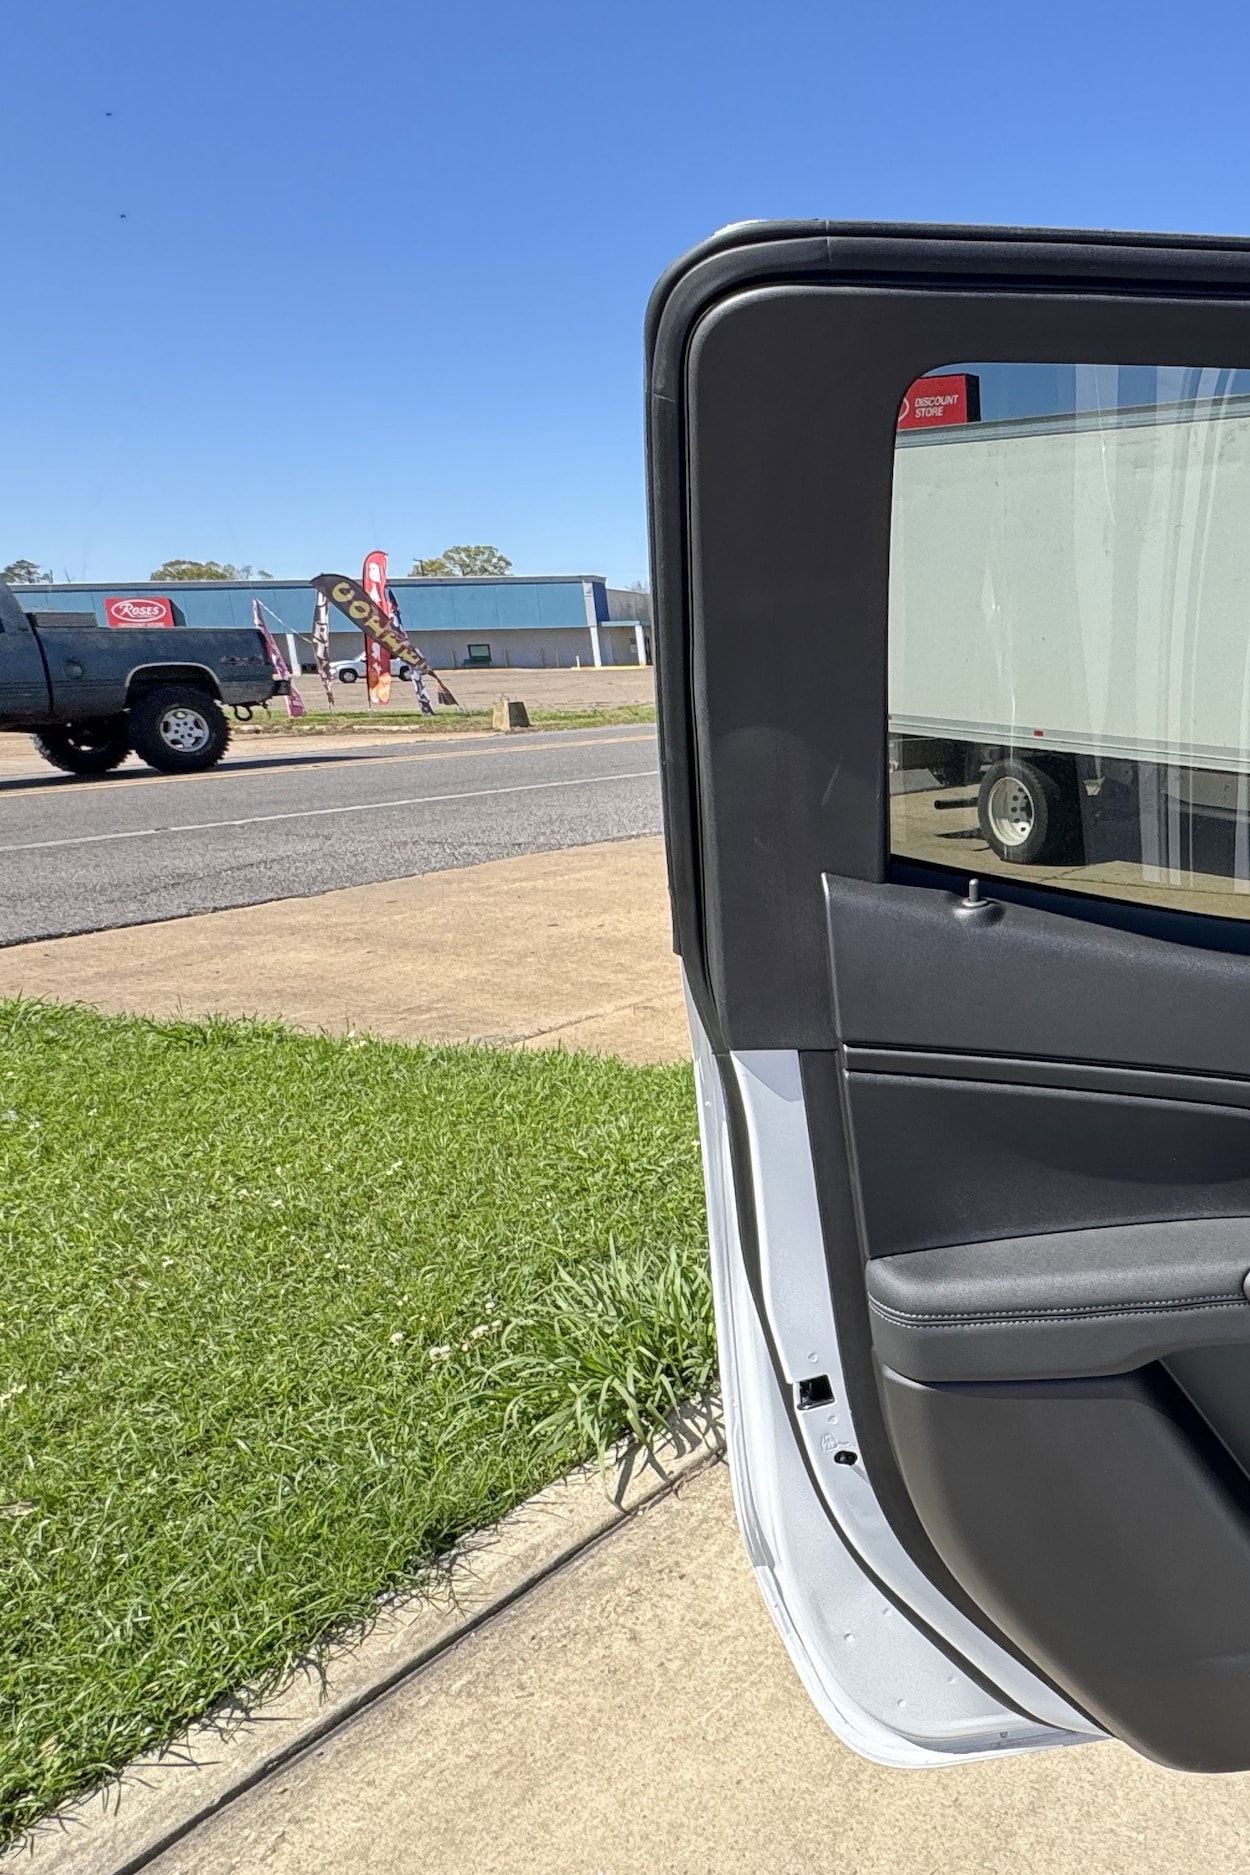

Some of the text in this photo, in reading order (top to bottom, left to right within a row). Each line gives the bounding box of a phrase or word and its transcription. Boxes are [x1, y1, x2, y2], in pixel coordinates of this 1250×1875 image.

[914, 394, 960, 407] DISCOUNT
[914, 406, 945, 418] STORE
[118, 601, 161, 618] ROSES
